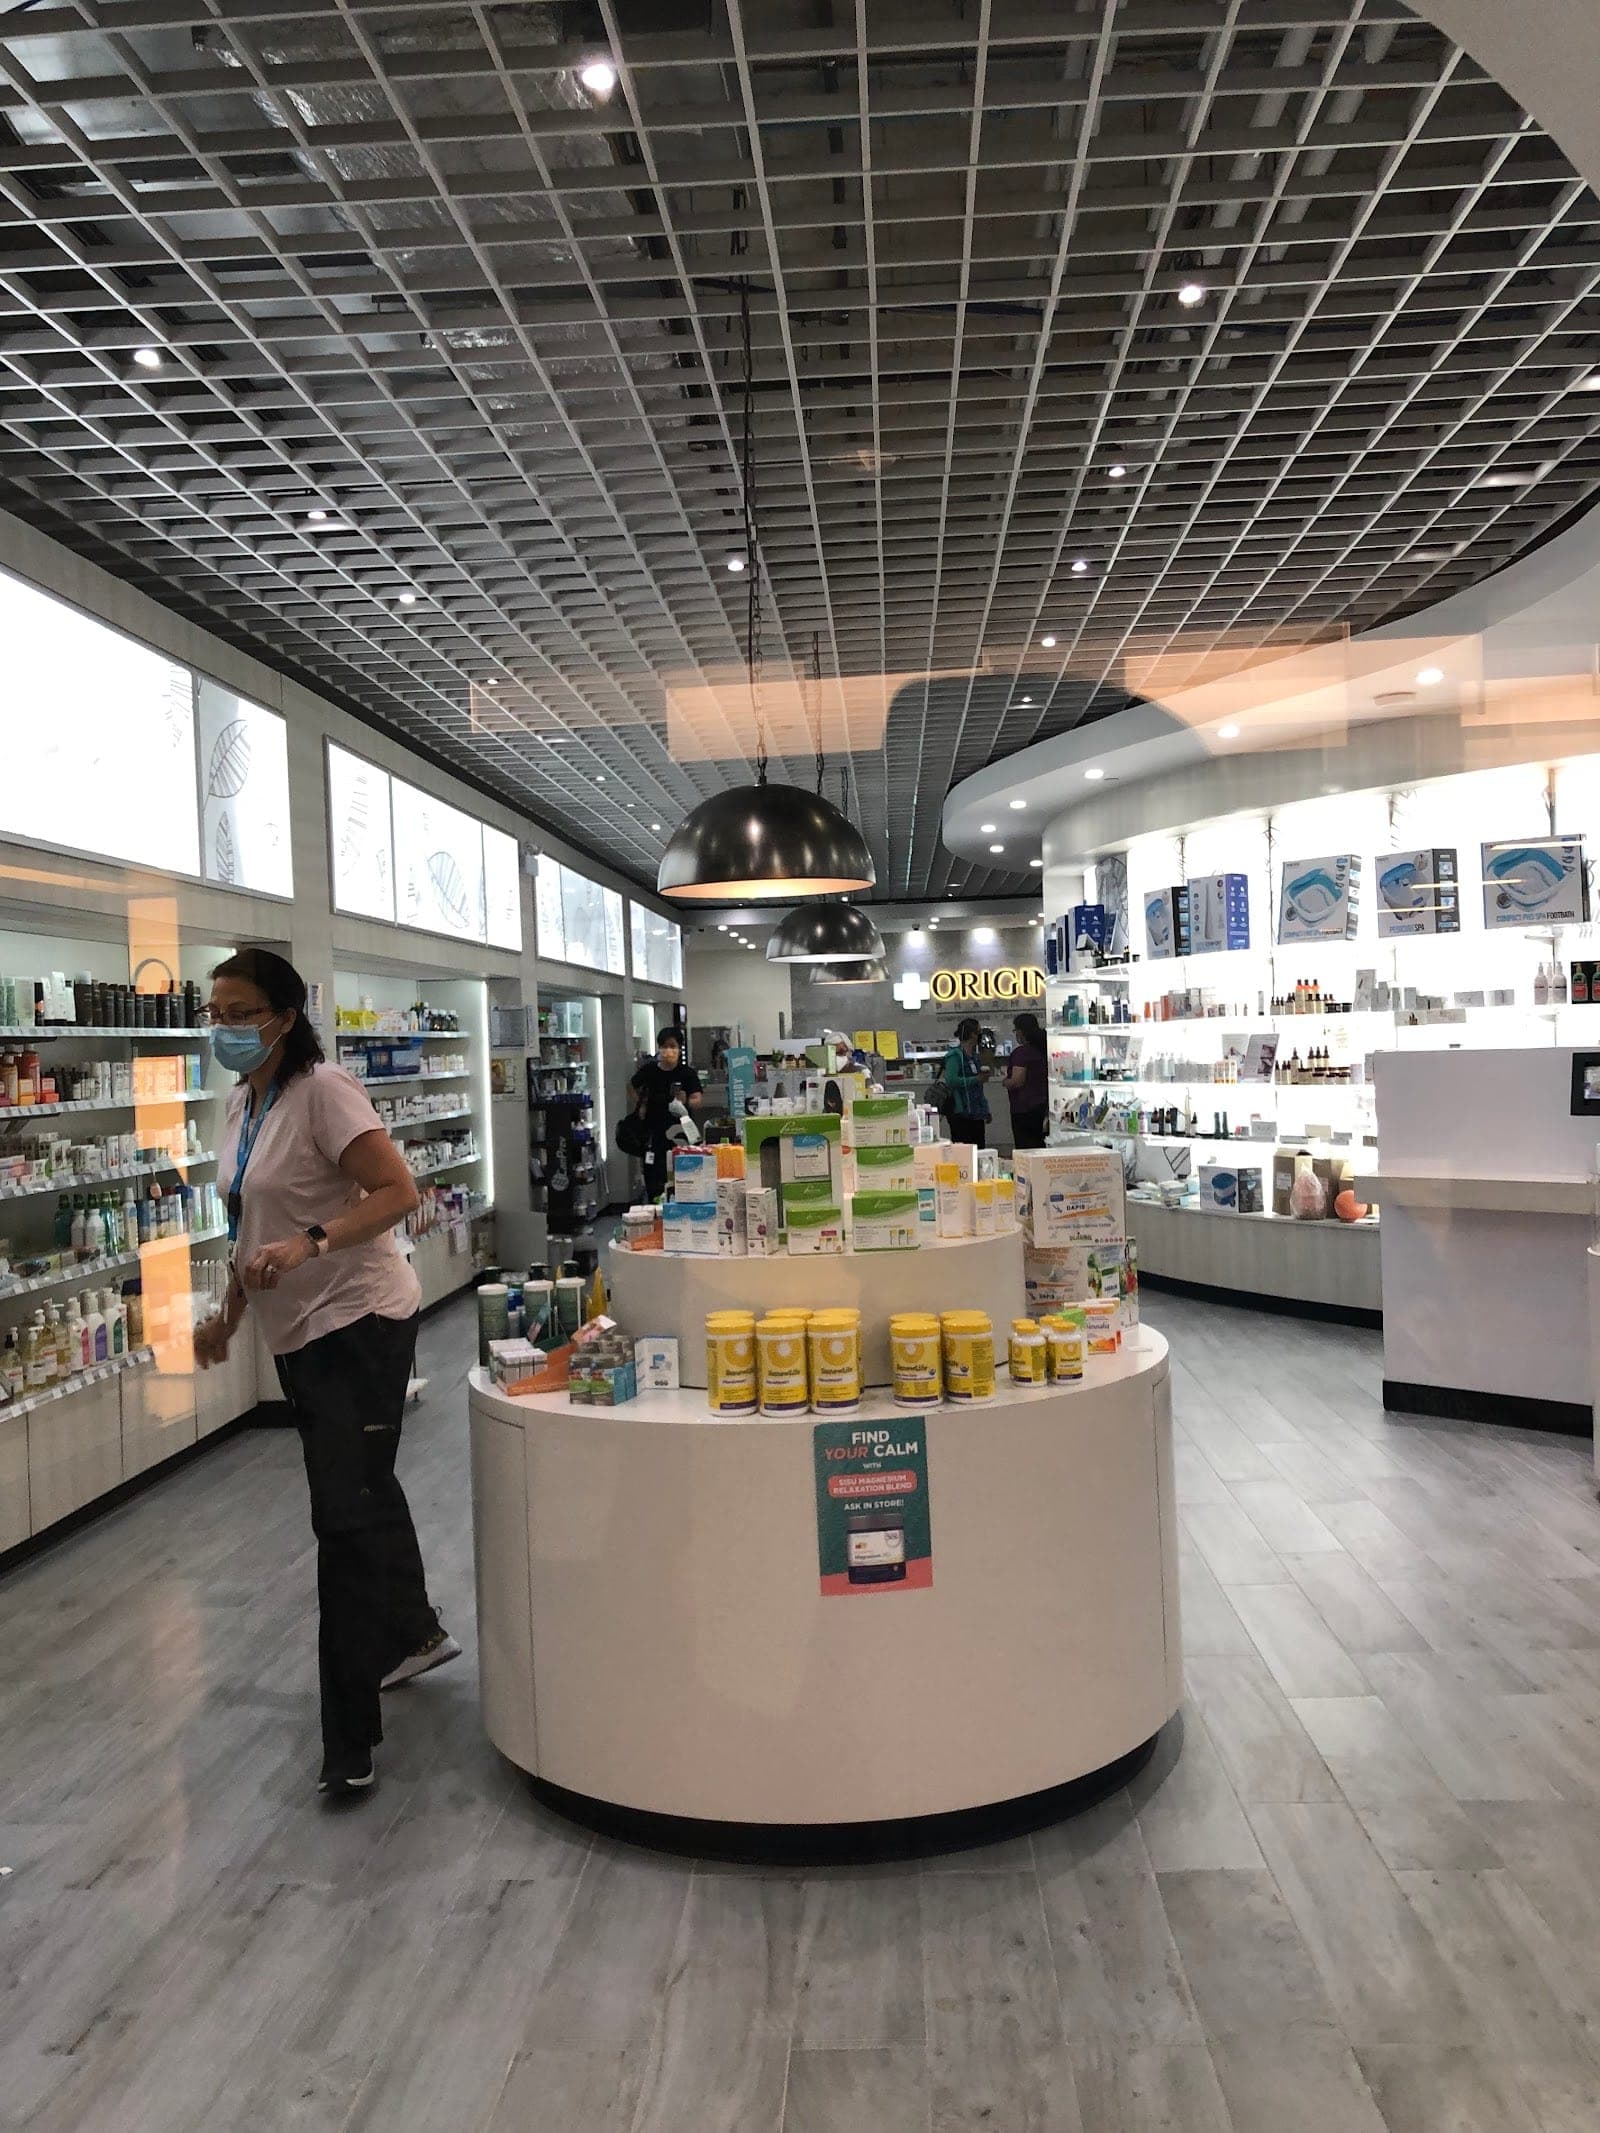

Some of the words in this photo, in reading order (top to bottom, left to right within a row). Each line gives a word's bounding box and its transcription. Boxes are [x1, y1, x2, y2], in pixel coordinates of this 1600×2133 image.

[852, 1430, 890, 1445] FIND
[825, 1446, 868, 1460] YOUR
[874, 1442, 918, 1457] CALM
[858, 1475, 907, 1485] MAGNESIUM
[833, 1484, 885, 1495] RELAXATION
[886, 1482, 912, 1491] BLEND
[844, 1502, 861, 1511] ASK
[863, 1501, 873, 1509] IN
[874, 1499, 905, 1509] STORE!
